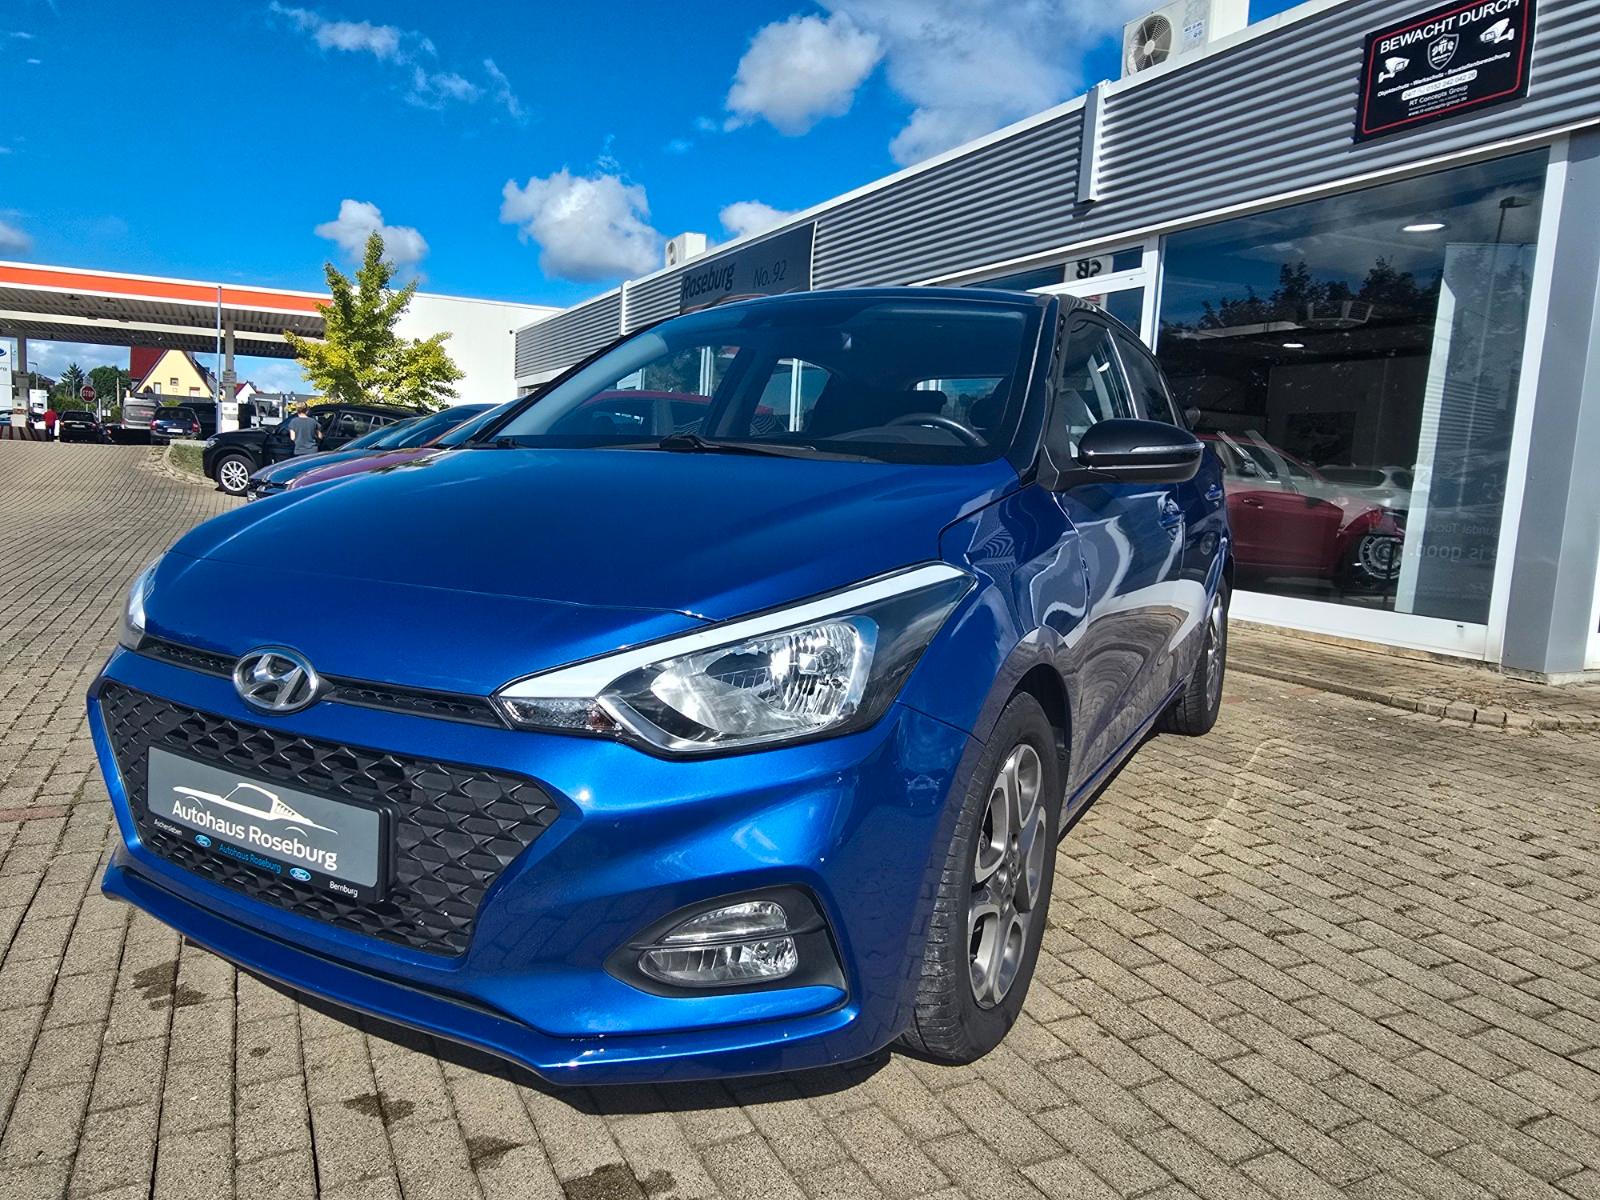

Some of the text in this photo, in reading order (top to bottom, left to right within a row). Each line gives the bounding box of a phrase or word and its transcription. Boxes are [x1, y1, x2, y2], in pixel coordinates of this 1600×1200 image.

[1380, 16, 1457, 54] BEWACHT
[1459, 0, 1520, 27] DURCH
[1419, 91, 1447, 104] Concepts
[1449, 85, 1468, 95] Group
[682, 259, 787, 301] Roseburg No. 92
[82, 388, 96, 398] STOP
[172, 800, 338, 871] Autohaus Roseburg
[219, 844, 282, 875] Autohaus Roseburg
[329, 881, 358, 898] Bernburg
